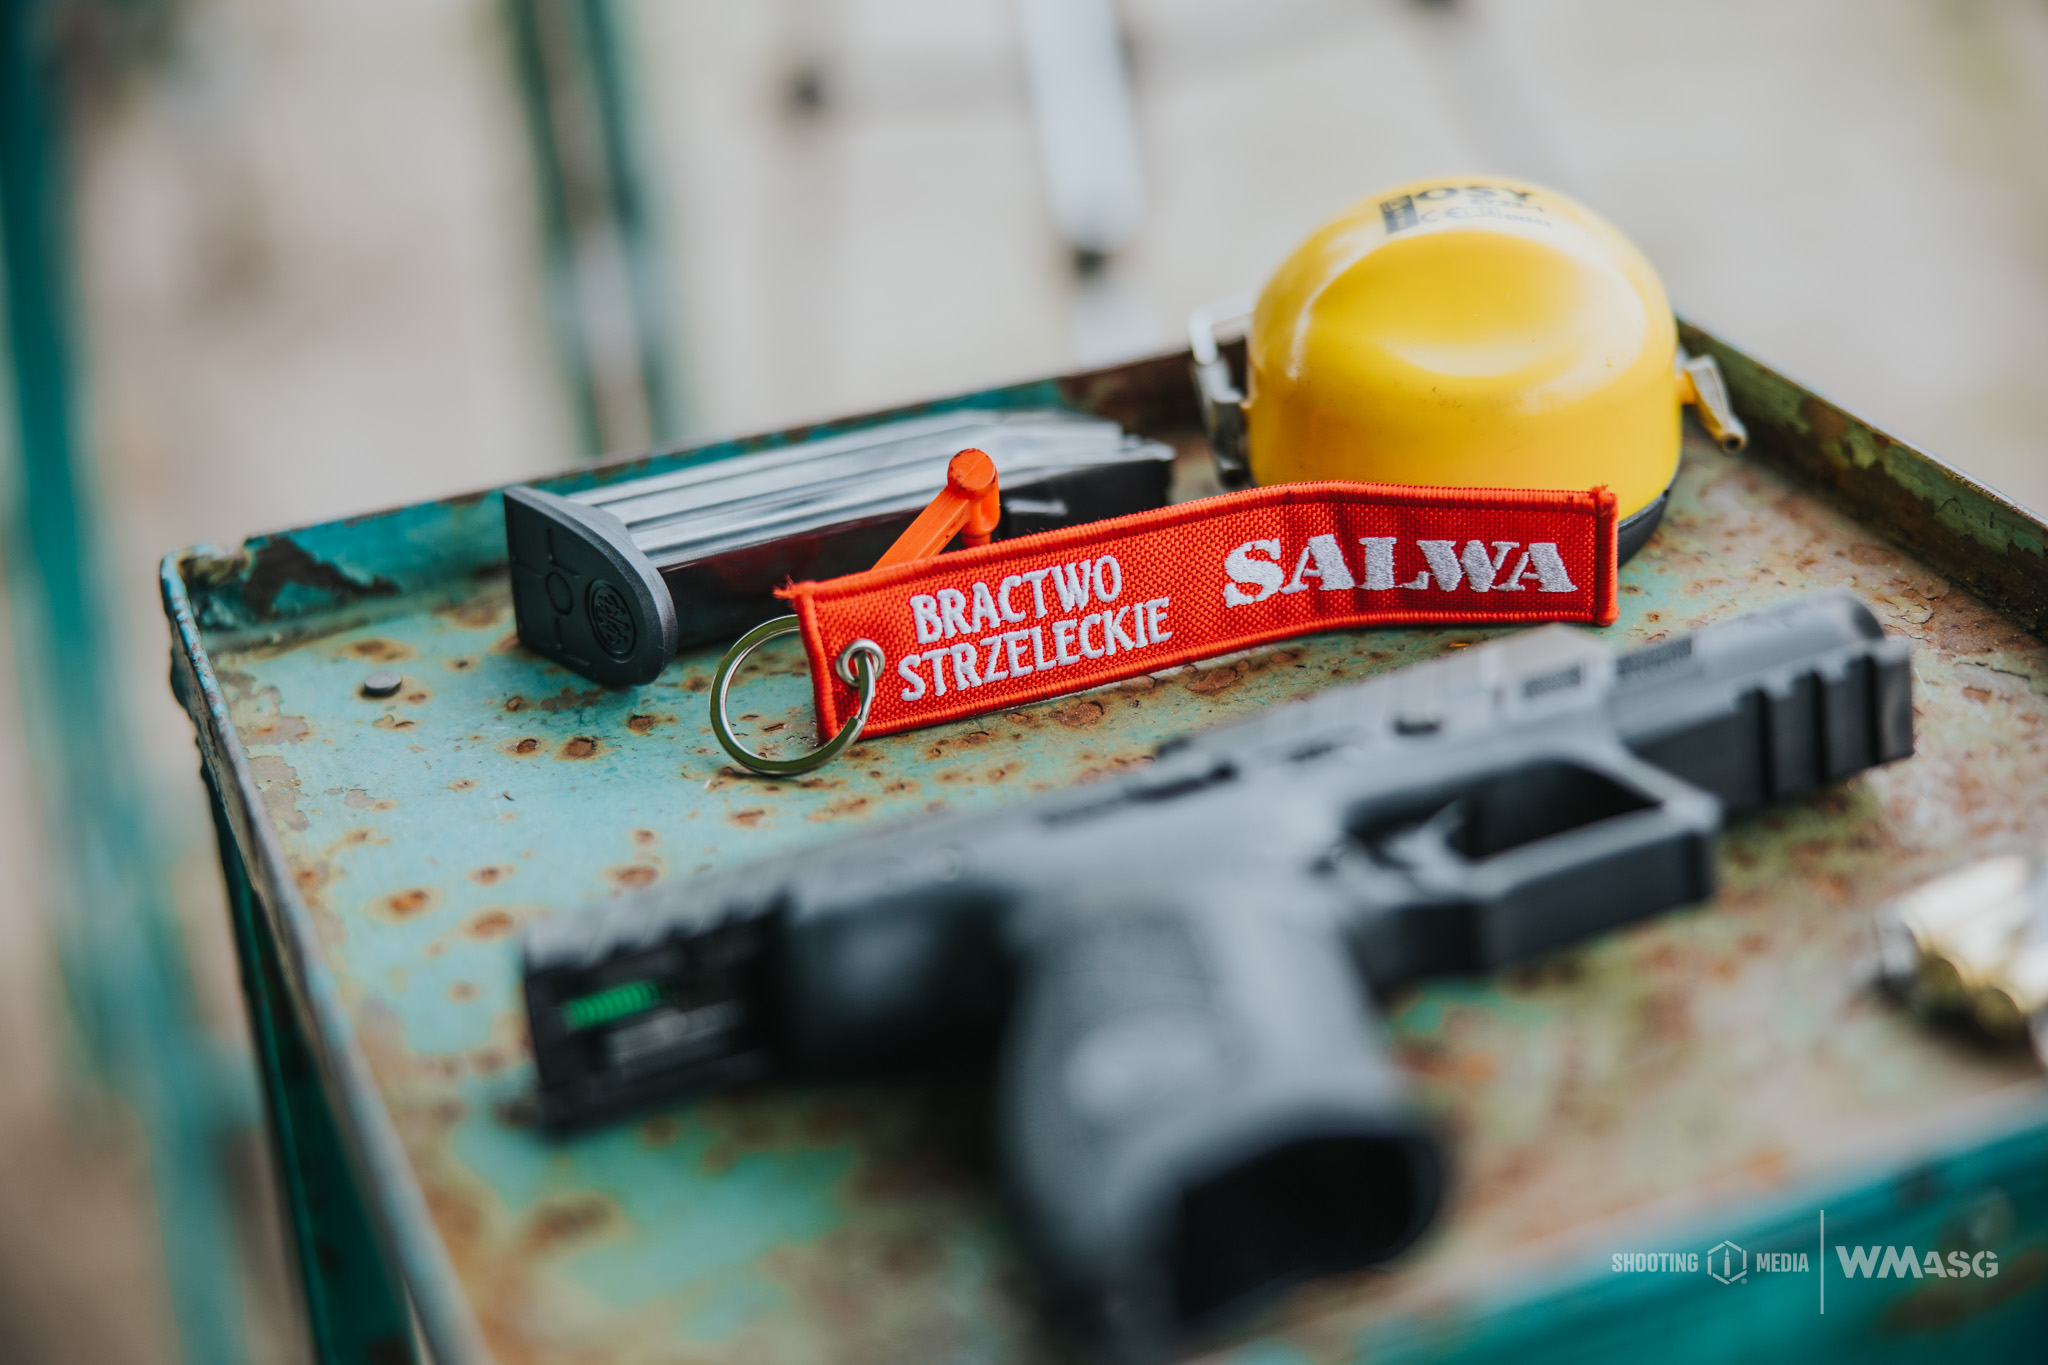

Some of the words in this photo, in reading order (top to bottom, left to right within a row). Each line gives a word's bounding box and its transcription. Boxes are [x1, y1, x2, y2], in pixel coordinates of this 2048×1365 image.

[910, 555, 1122, 644] BRACTWO
[1223, 533, 1578, 608] SALWA
[898, 597, 1173, 701] STRZELECKIE
